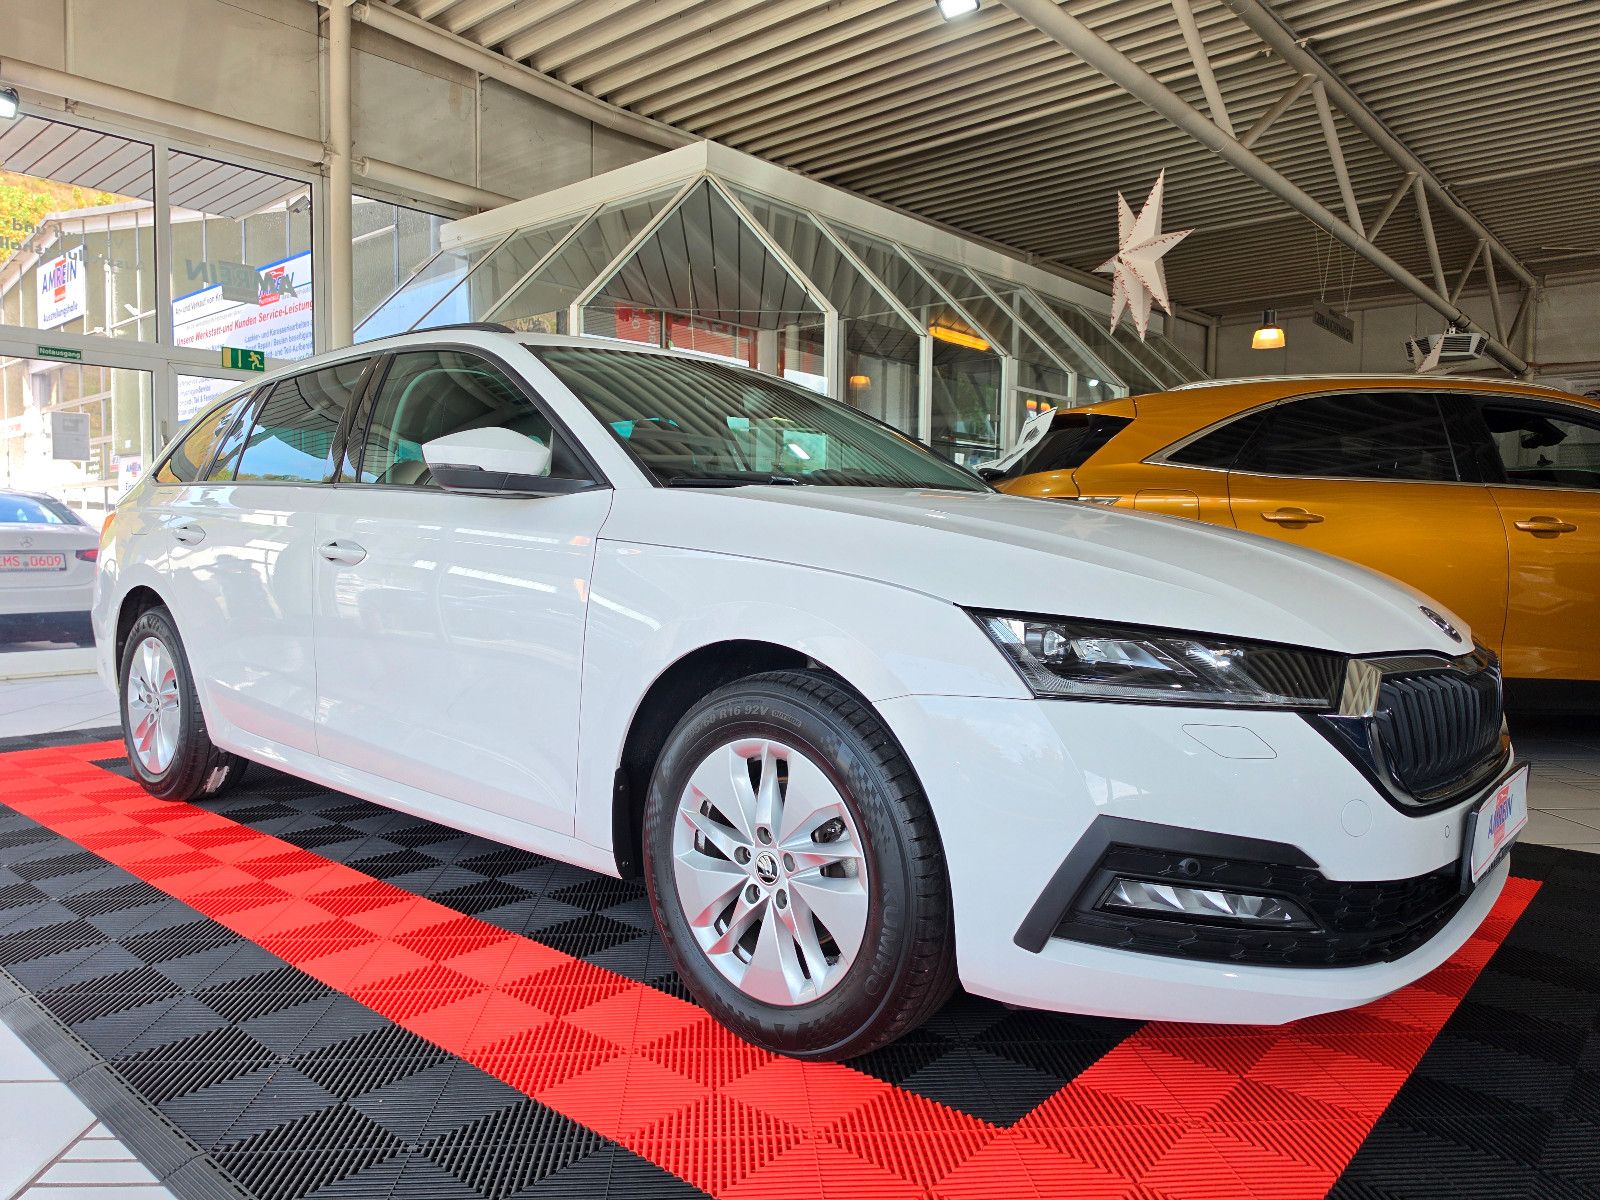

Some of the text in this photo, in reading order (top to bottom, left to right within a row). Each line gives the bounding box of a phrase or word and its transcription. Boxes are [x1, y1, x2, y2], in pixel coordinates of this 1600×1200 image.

[42, 260, 78, 295] AMREIN
[176, 334, 195, 347] Unsere
[234, 315, 257, 331] Kunden
[39, 347, 81, 359] Notausgang
[30, 556, 61, 567] 0609
[744, 704, 770, 717] 92V
